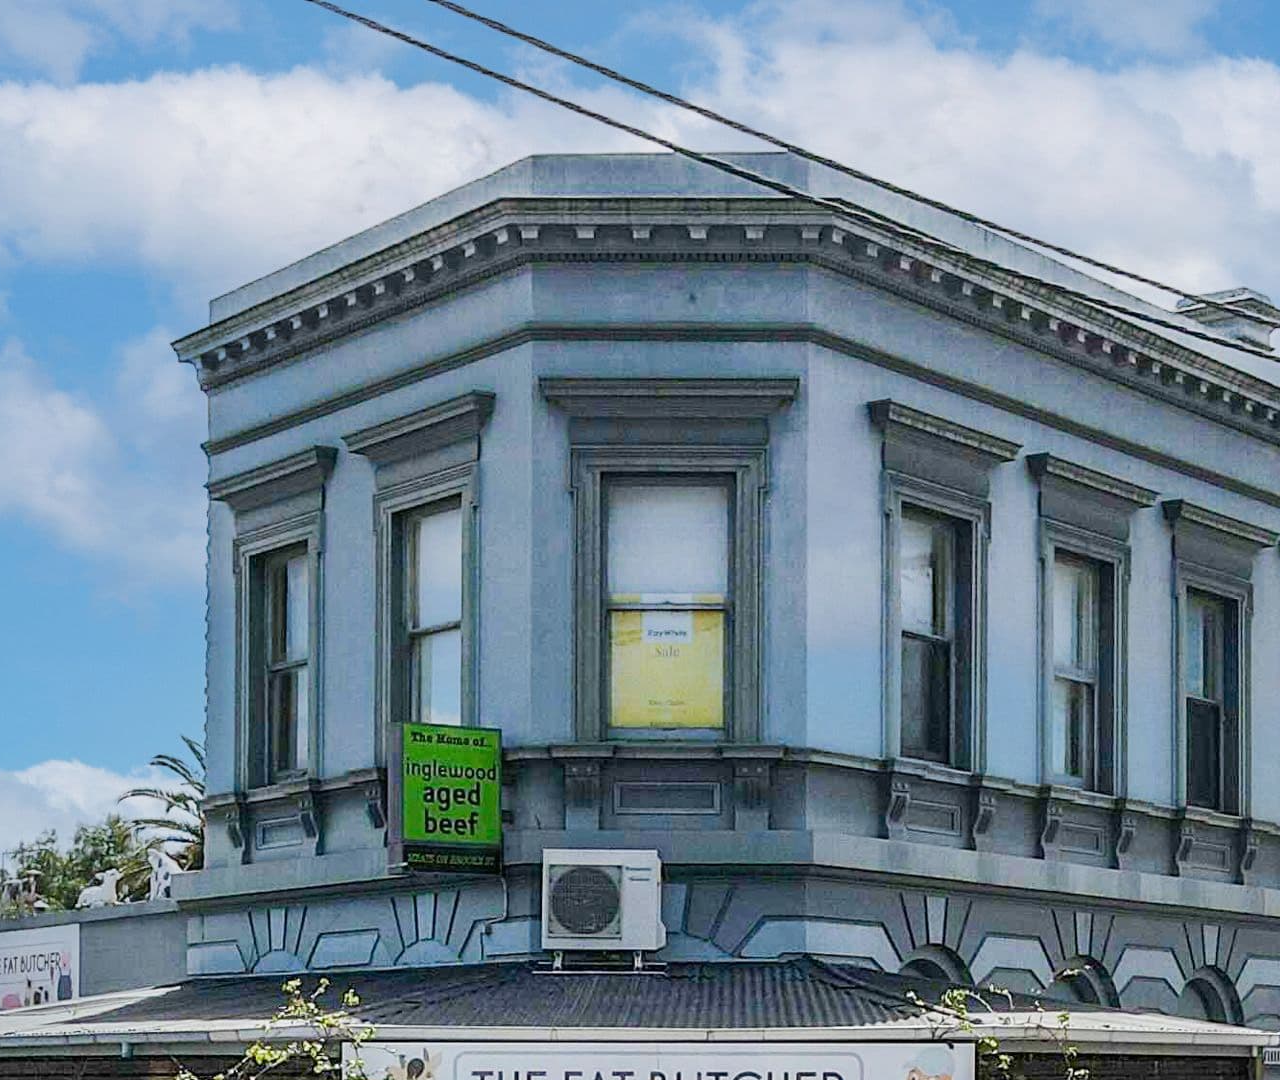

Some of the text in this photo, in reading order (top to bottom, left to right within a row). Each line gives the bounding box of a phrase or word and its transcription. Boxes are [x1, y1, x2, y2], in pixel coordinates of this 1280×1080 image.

[410, 732, 433, 743] The
[437, 734, 470, 746] Home
[406, 757, 497, 781] inglewood
[423, 782, 481, 811] aged
[424, 807, 479, 836] beef
[4, 956, 18, 974] FAT
[21, 952, 61, 973] BUTCHER
